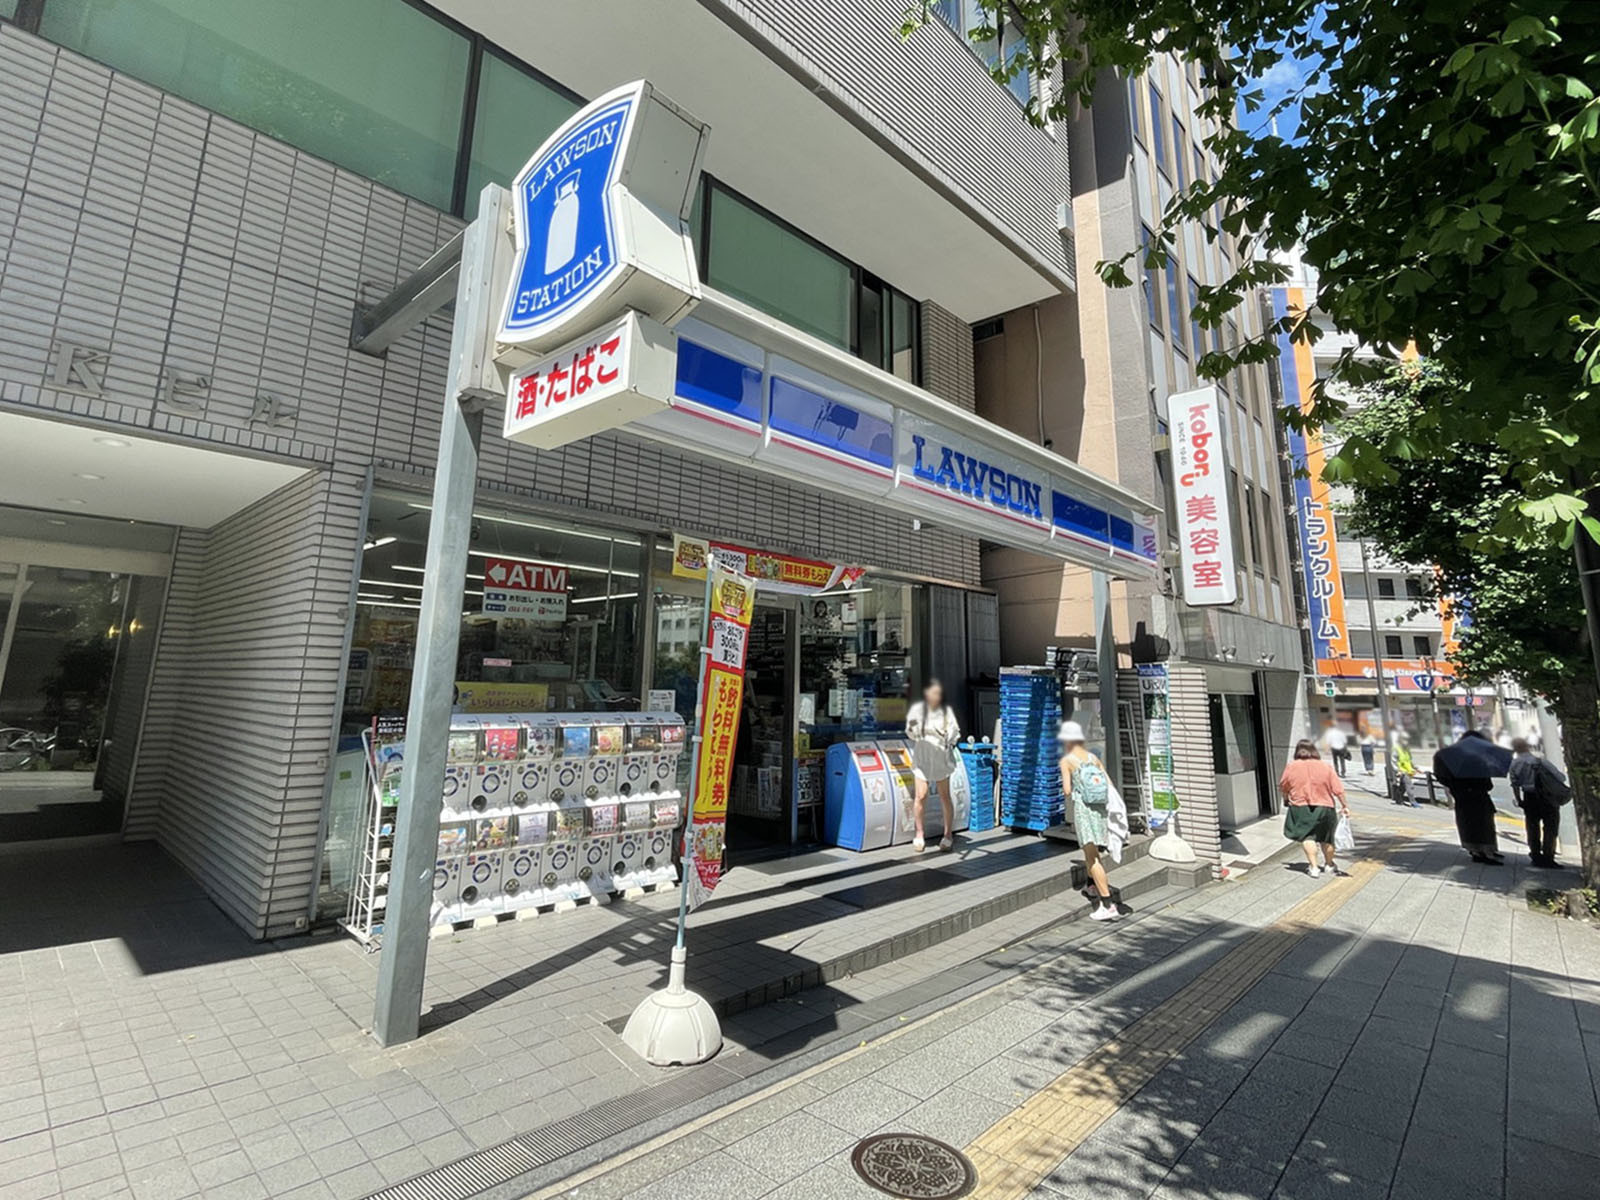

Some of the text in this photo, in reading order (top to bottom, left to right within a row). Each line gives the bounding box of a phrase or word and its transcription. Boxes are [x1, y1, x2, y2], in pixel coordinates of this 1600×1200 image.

[529, 120, 619, 202] LAWSON
[516, 246, 603, 314] STATION
[515, 335, 621, 420] 酒・たばこ
[911, 434, 1043, 519] LAWSON
[507, 564, 567, 591] ATM
[1185, 493, 1224, 589] 美容室
[1303, 496, 1341, 641] トランクルーム
[1416, 676, 1431, 688] 17
[711, 687, 739, 806] 飲料無料券
